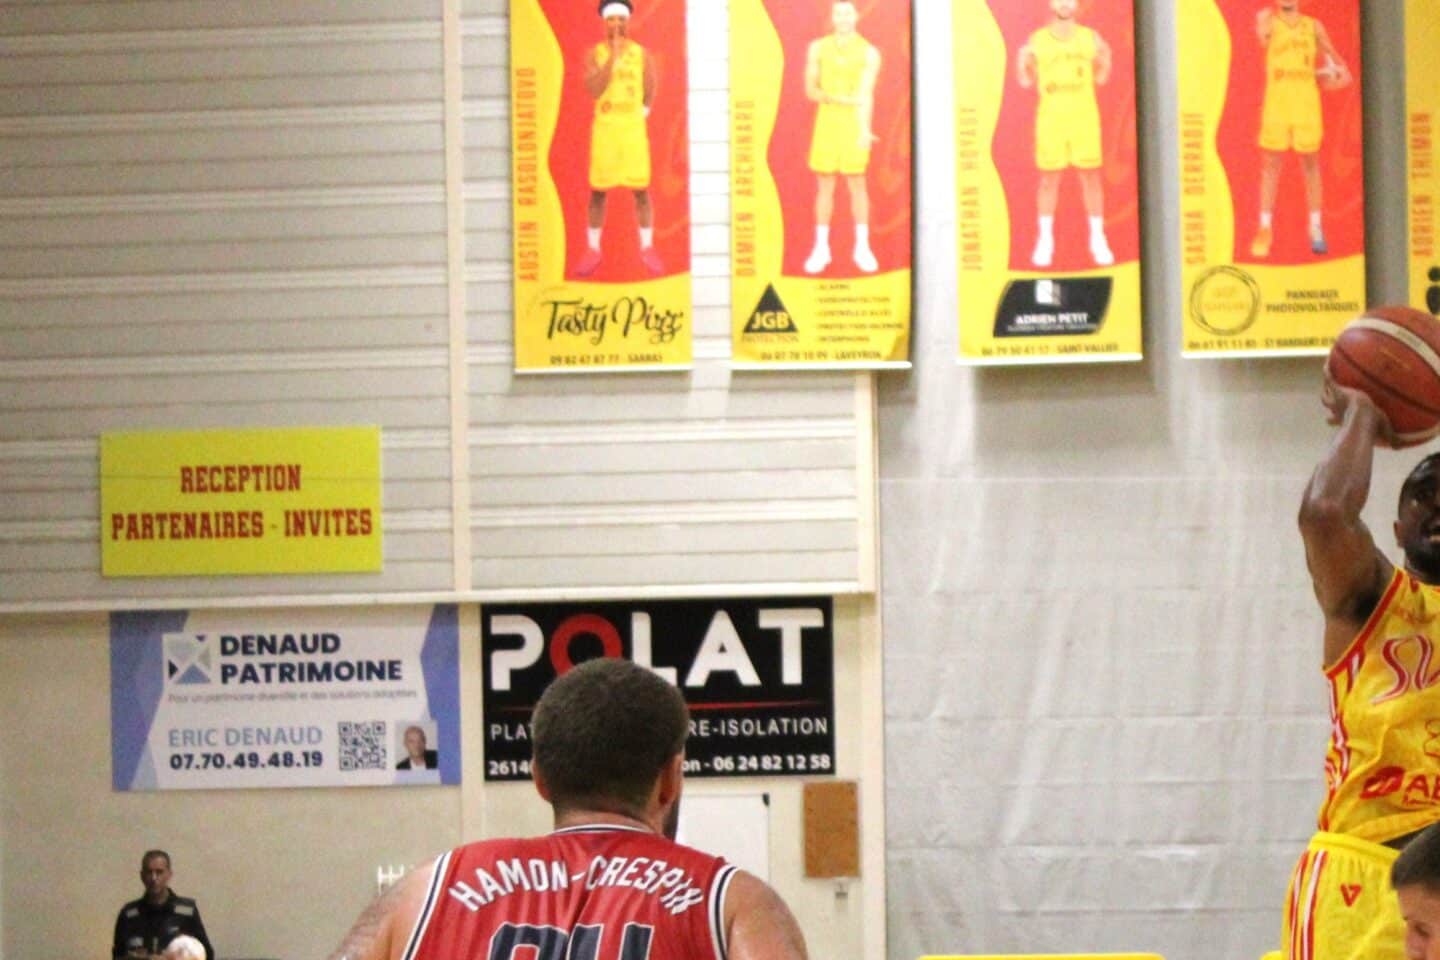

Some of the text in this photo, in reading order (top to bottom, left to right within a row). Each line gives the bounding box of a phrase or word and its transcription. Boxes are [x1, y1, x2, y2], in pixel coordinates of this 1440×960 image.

[735, 213, 755, 277] DAMIEN
[541, 298, 608, 345] Tasty
[751, 311, 790, 329] JGB
[181, 464, 301, 493] RECEPTION
[111, 511, 264, 540] PARTENAIRES
[284, 508, 372, 537] INVITES
[220, 633, 341, 657] DENAUD
[490, 608, 824, 691] POLAT
[220, 660, 402, 685] PATRIMOINE
[168, 725, 323, 748] ERIC DENAUD
[170, 751, 323, 770] 07.70.49.48.19
[713, 756, 734, 772] 06
[738, 755, 759, 770] 24
[761, 755, 782, 770] 82
[787, 754, 807, 770] 12
[809, 754, 831, 769] 58
